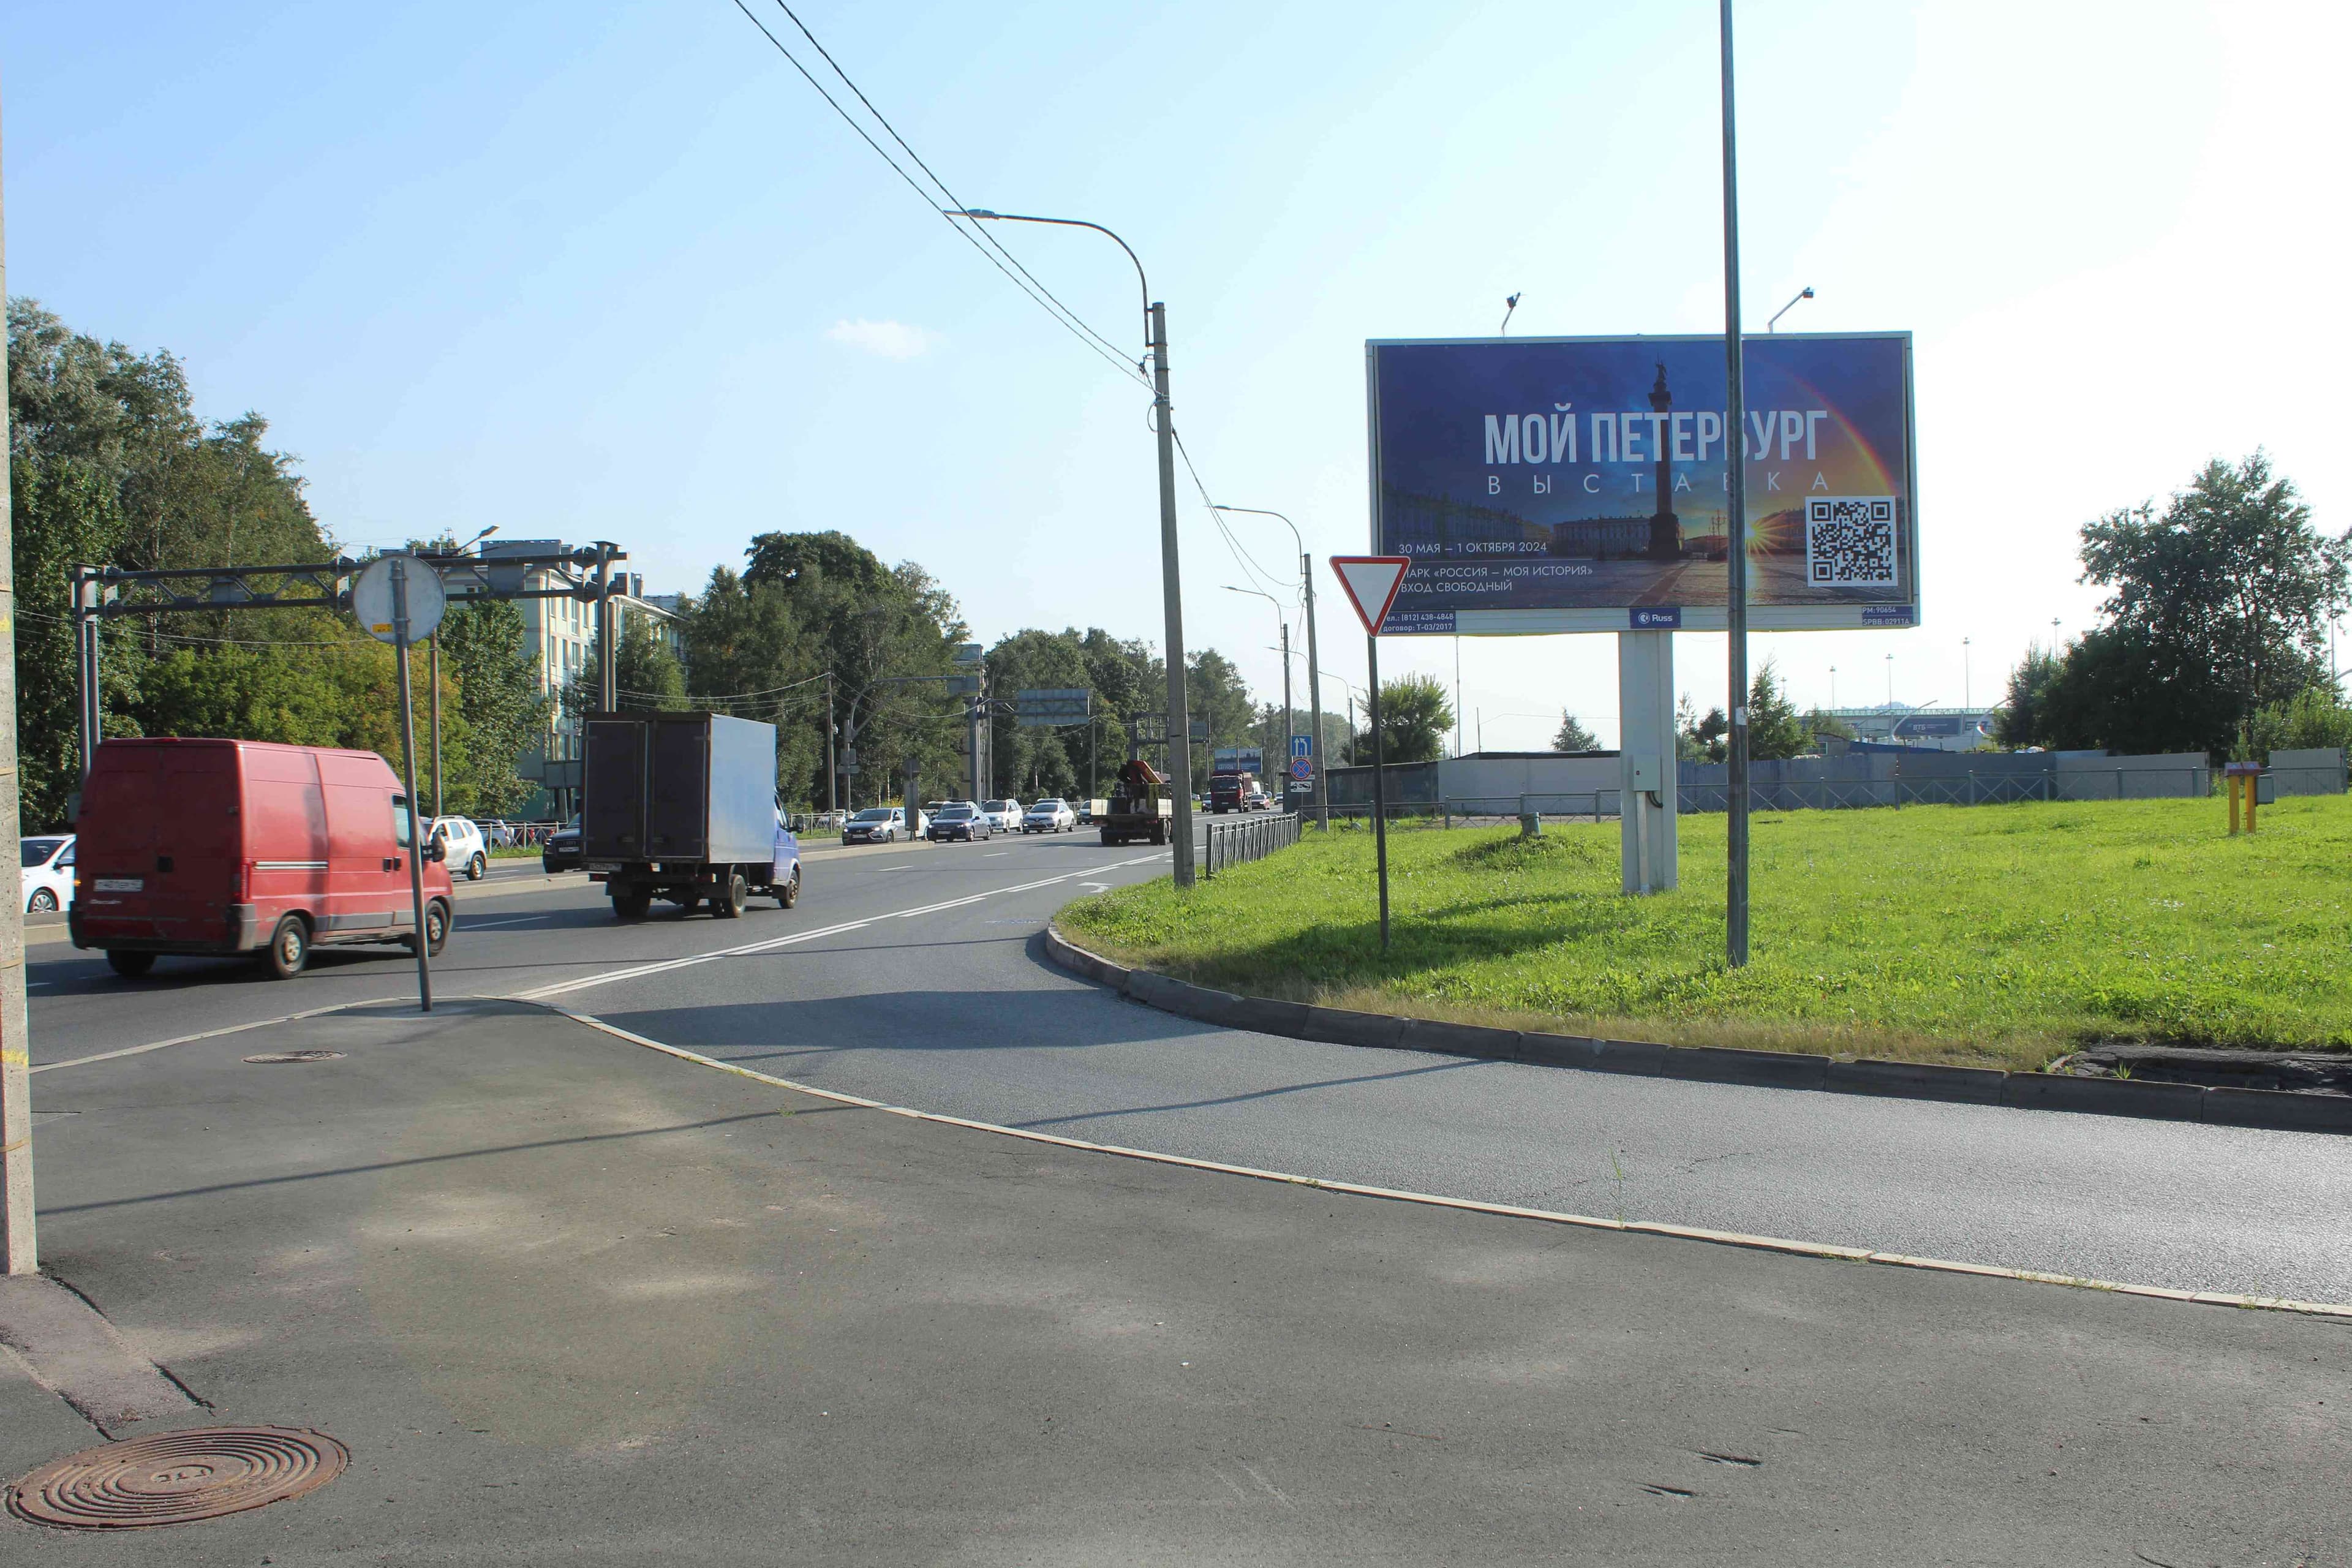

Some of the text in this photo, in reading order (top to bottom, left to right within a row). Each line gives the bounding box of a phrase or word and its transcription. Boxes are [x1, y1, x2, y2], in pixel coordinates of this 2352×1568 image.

[1485, 402, 1577, 464] МОЙ
[1398, 544, 1412, 554] 30
[1415, 543, 1441, 553] МАЯ
[1457, 543, 1462, 552] 1
[1466, 542, 1515, 552] ОКТЯБРЯ
[1518, 541, 1547, 552] 2024
[1433, 567, 1488, 578] «РОССИЯ
[1503, 567, 1529, 576] МОЯ
[1532, 565, 1593, 576] ИСТОРИЯ»
[1401, 579, 1512, 593] ВХОД СВОБОДНЫЙ
